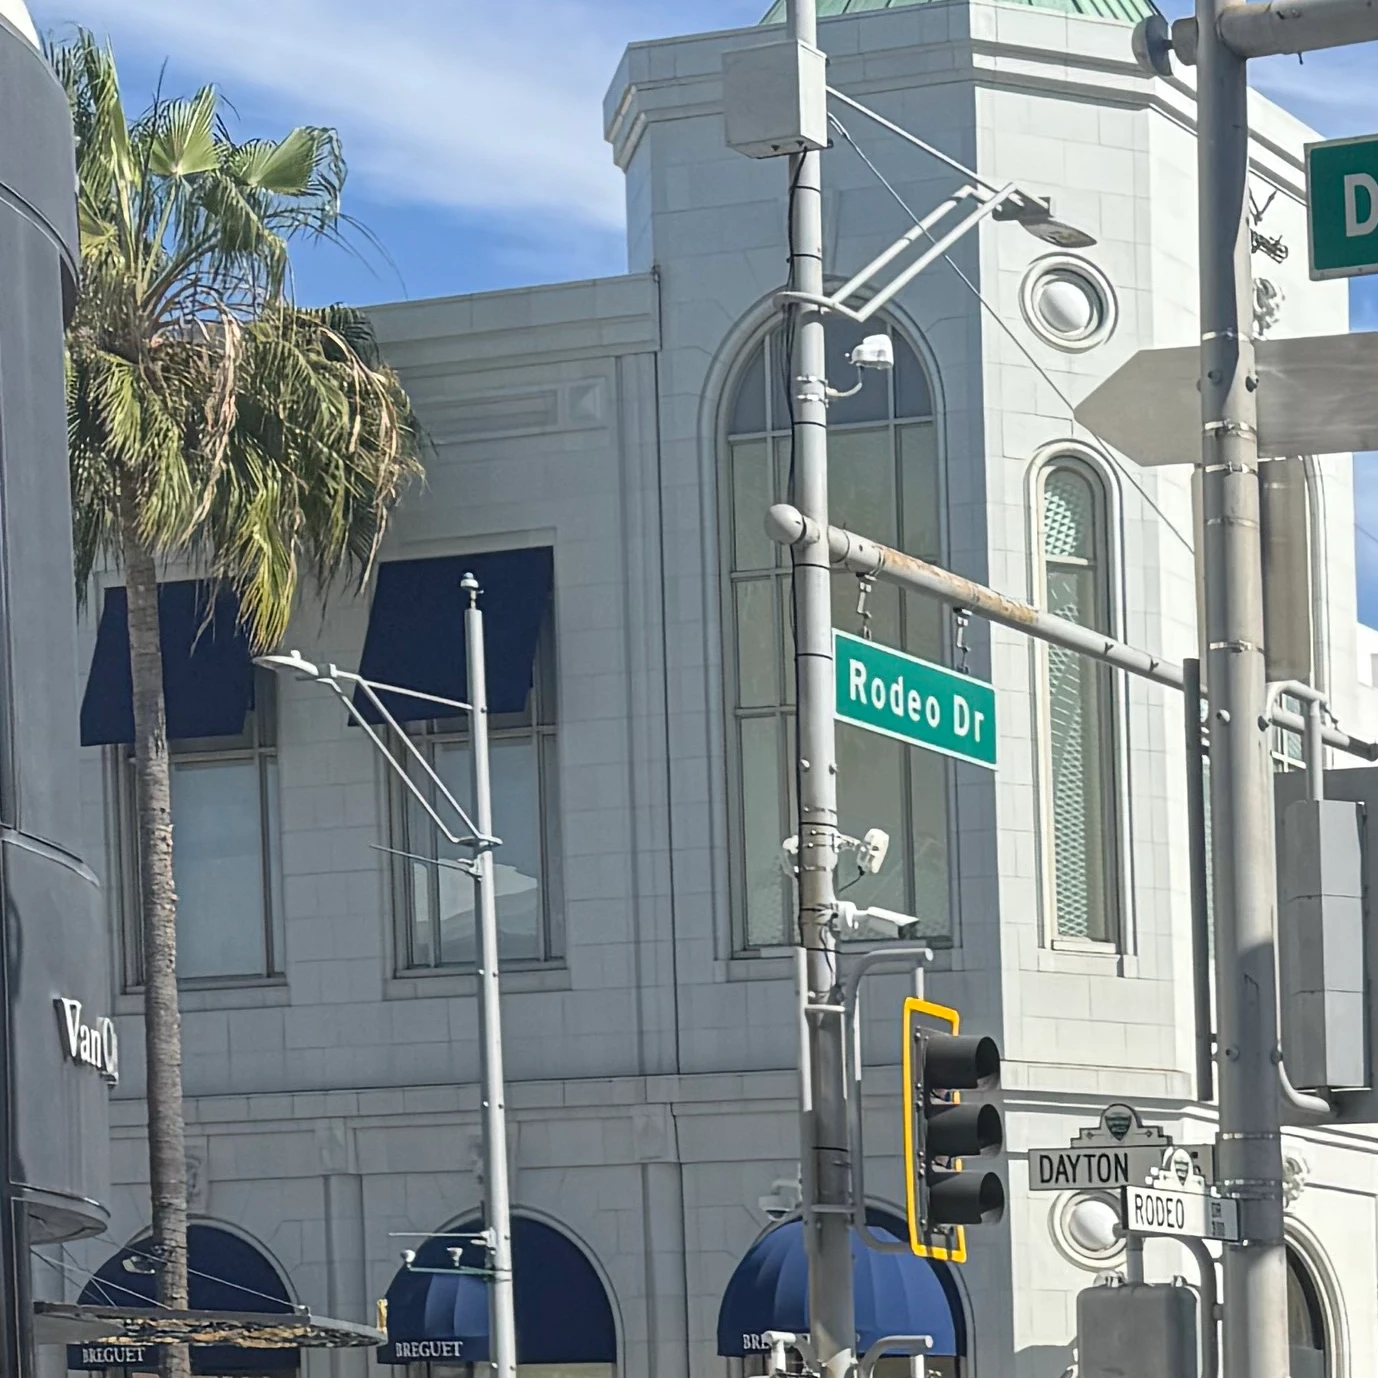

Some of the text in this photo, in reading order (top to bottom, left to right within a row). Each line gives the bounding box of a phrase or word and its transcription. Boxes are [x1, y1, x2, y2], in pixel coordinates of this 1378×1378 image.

[849, 659, 984, 742] Rodeo Dr
[61, 997, 102, 1068] Van
[1039, 1152, 1129, 1184] DAYTON
[1134, 1193, 1185, 1230] RODEO
[82, 1347, 146, 1363] BREGUET
[395, 1341, 464, 1357] BREGUET
